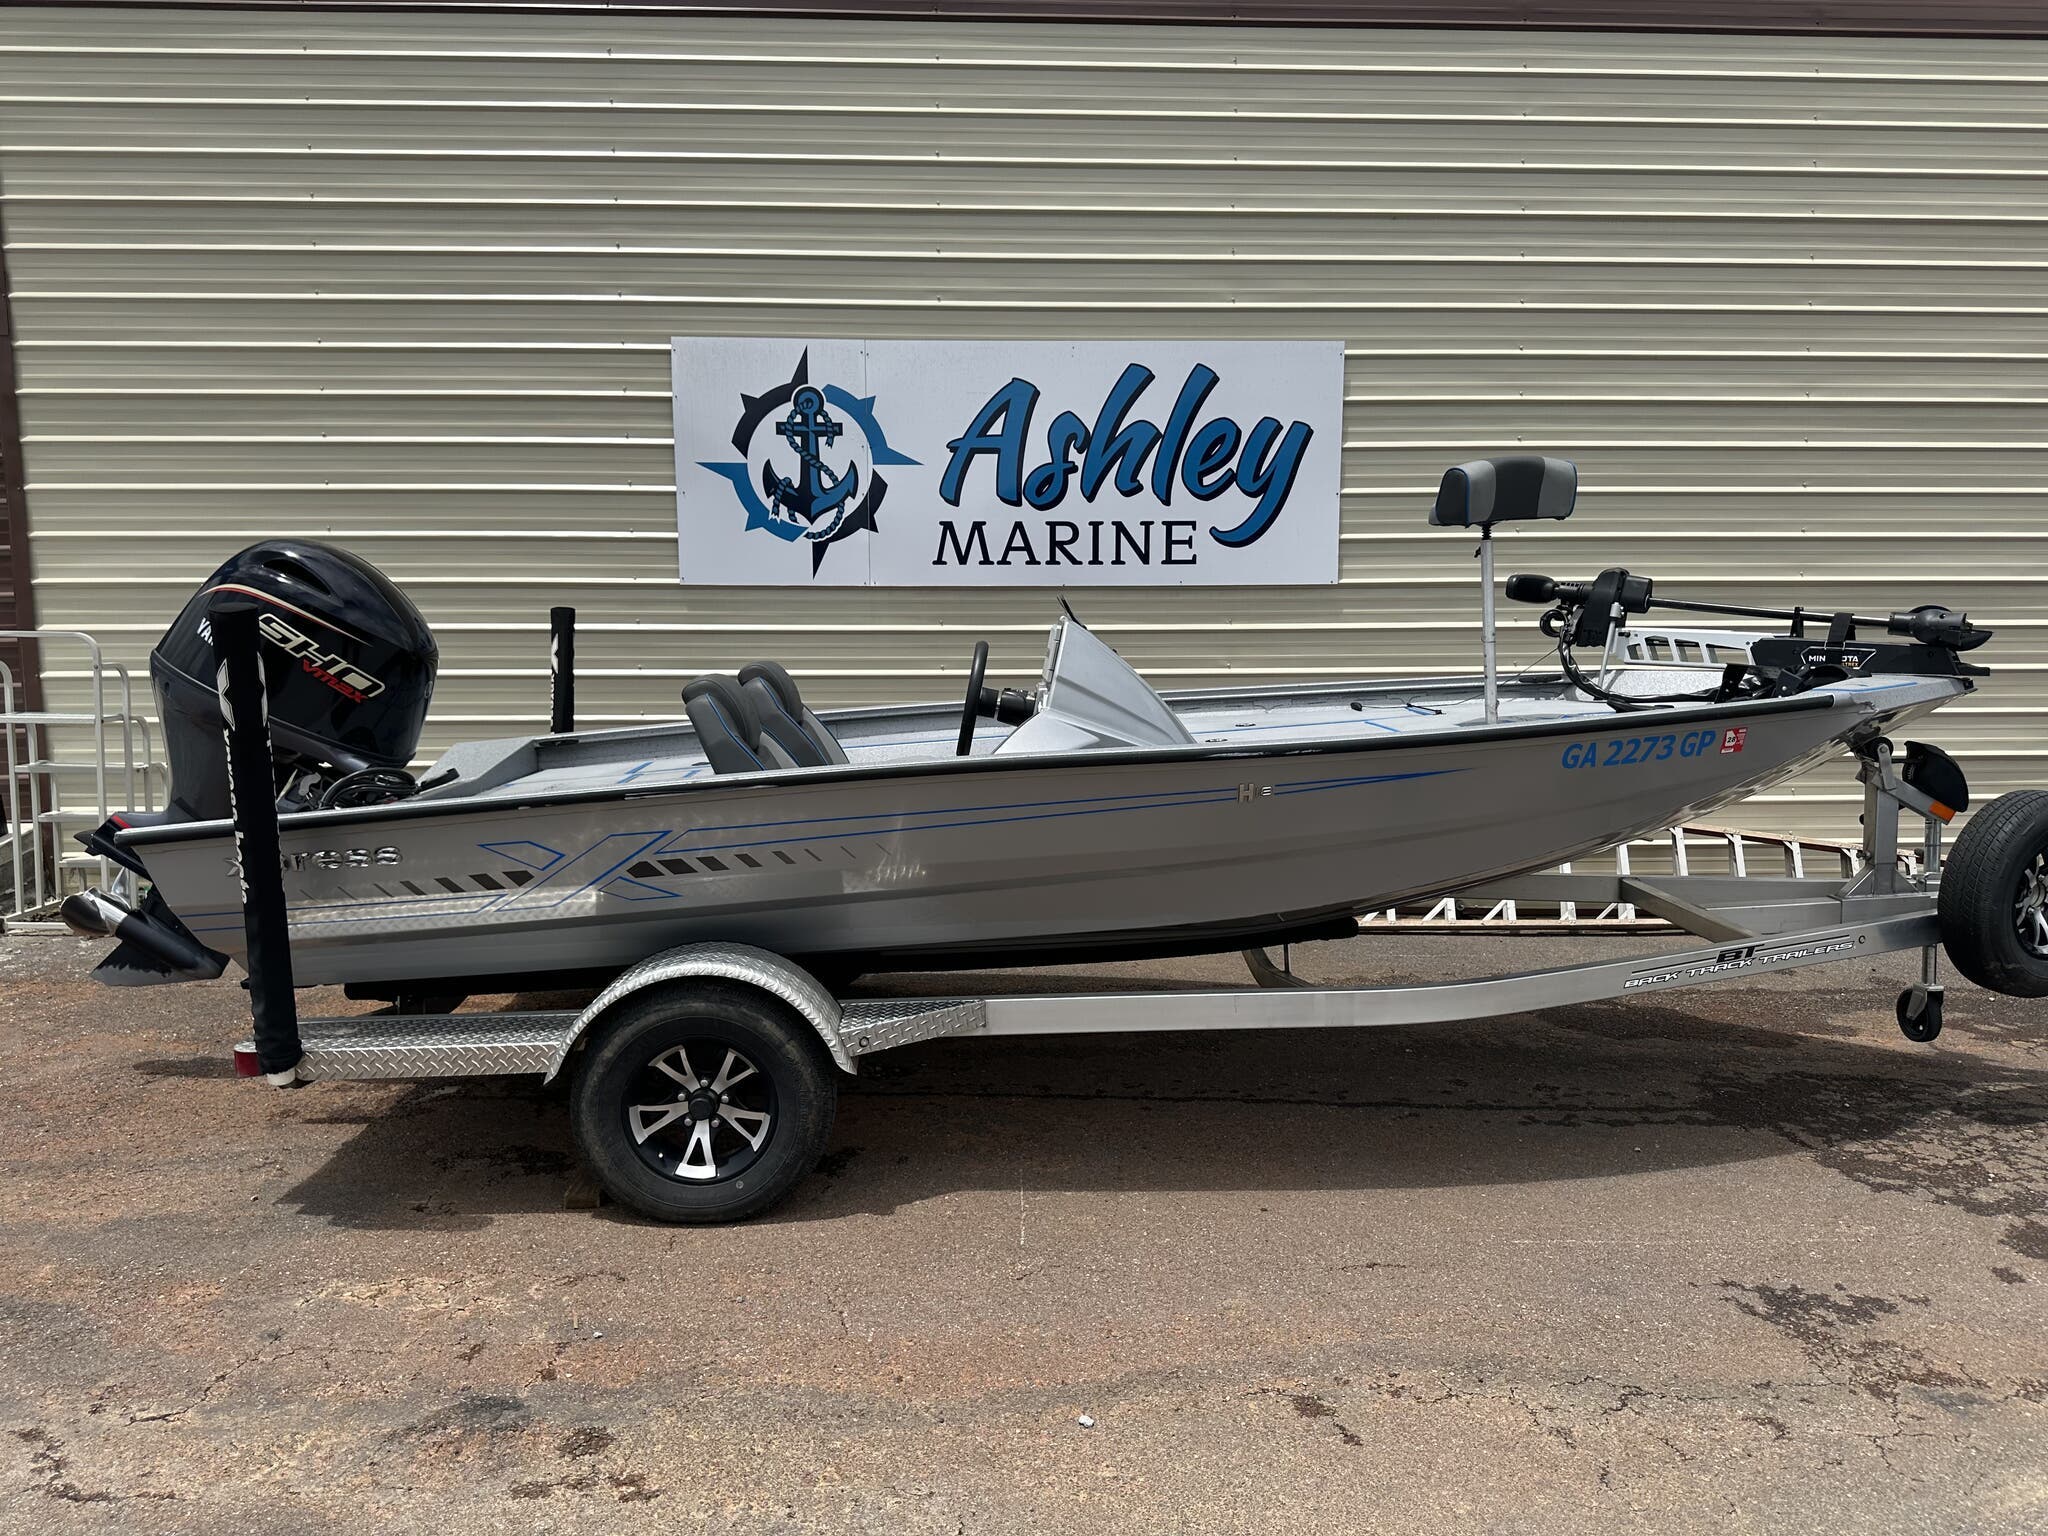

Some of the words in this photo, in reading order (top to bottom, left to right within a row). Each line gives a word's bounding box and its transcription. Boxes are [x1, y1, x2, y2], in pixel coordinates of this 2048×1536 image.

[939, 362, 1314, 548] Ashley
[932, 520, 1197, 565] MARINE
[1561, 742, 1597, 769] GA
[1603, 734, 1677, 766] 2273
[1680, 730, 1717, 758] GP
[1623, 970, 1682, 989] BACK
[1685, 957, 1755, 978] TRACK
[1758, 940, 1856, 966] TRAILERS
[1716, 943, 1765, 964] BT
